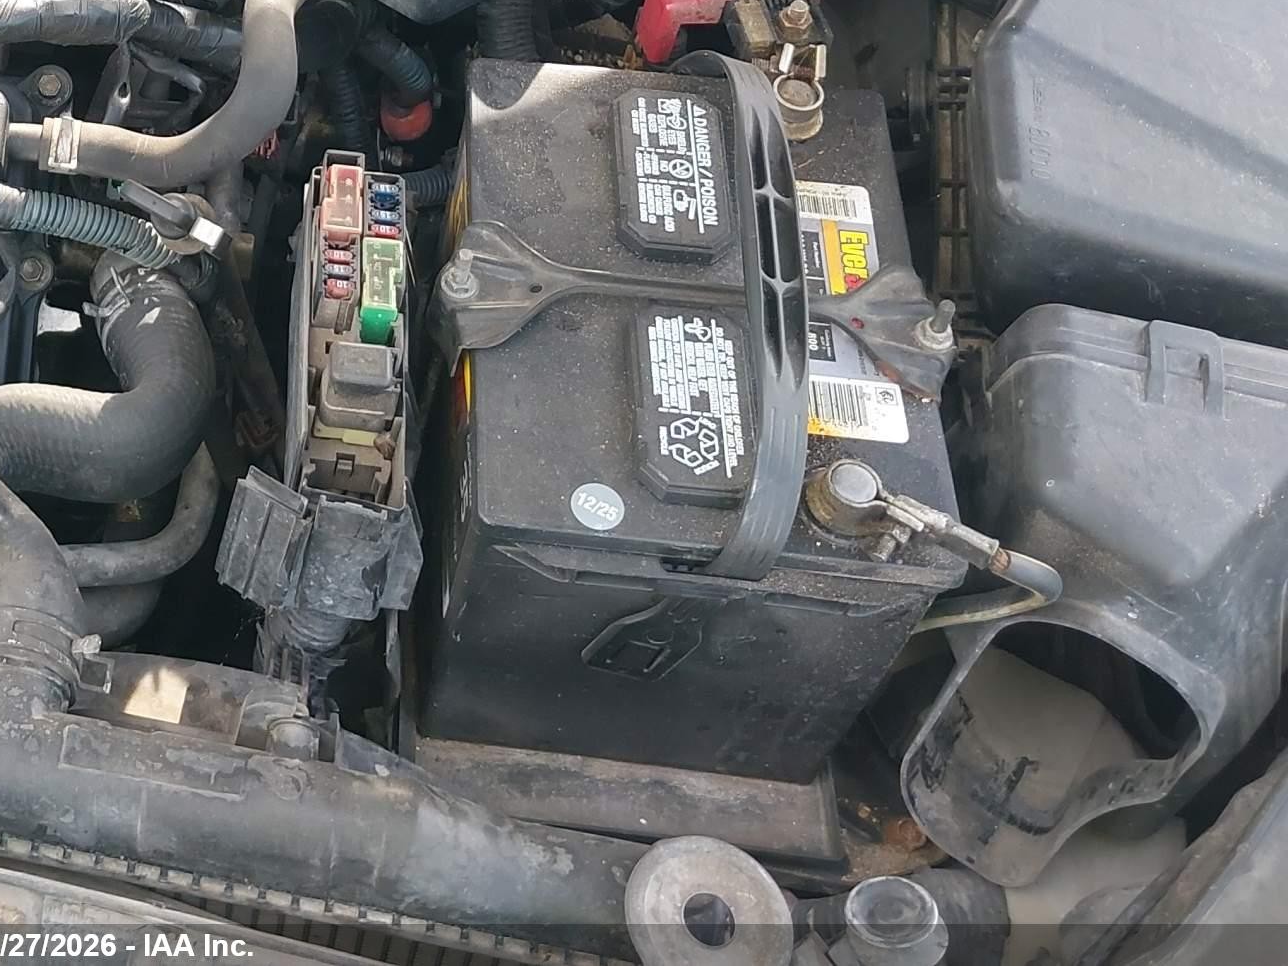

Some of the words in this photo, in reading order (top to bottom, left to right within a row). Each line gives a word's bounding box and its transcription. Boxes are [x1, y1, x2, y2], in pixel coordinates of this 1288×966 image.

[693, 118, 712, 168] DANGER
[700, 178, 719, 226] POISON
[577, 492, 619, 522] 12/25
